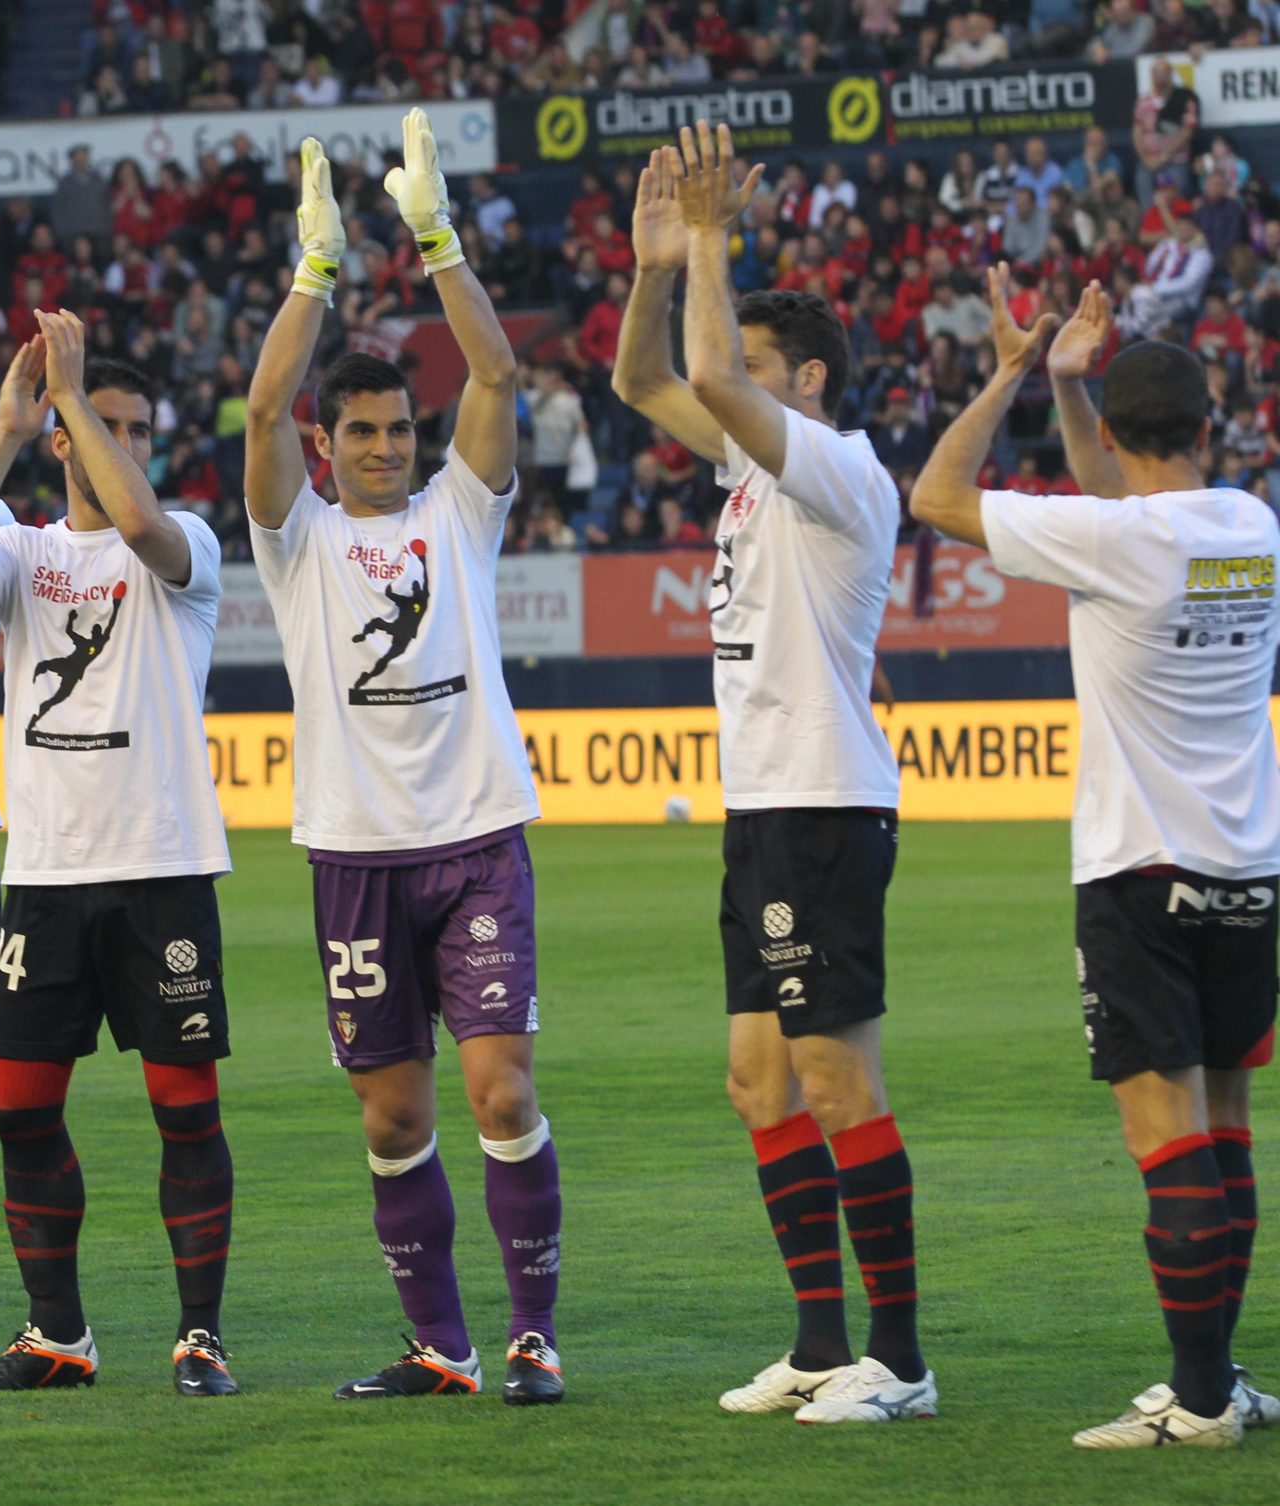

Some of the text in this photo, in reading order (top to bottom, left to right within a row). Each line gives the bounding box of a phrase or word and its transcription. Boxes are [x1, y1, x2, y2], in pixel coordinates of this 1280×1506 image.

[597, 88, 793, 135] diametro
[891, 70, 1095, 118] diametro
[1185, 554, 1275, 590] JUNTOS
[587, 730, 722, 785] CONT
[898, 724, 1069, 779] AMBRE
[158, 979, 213, 996] Navarra
[327, 938, 388, 1000] 25
